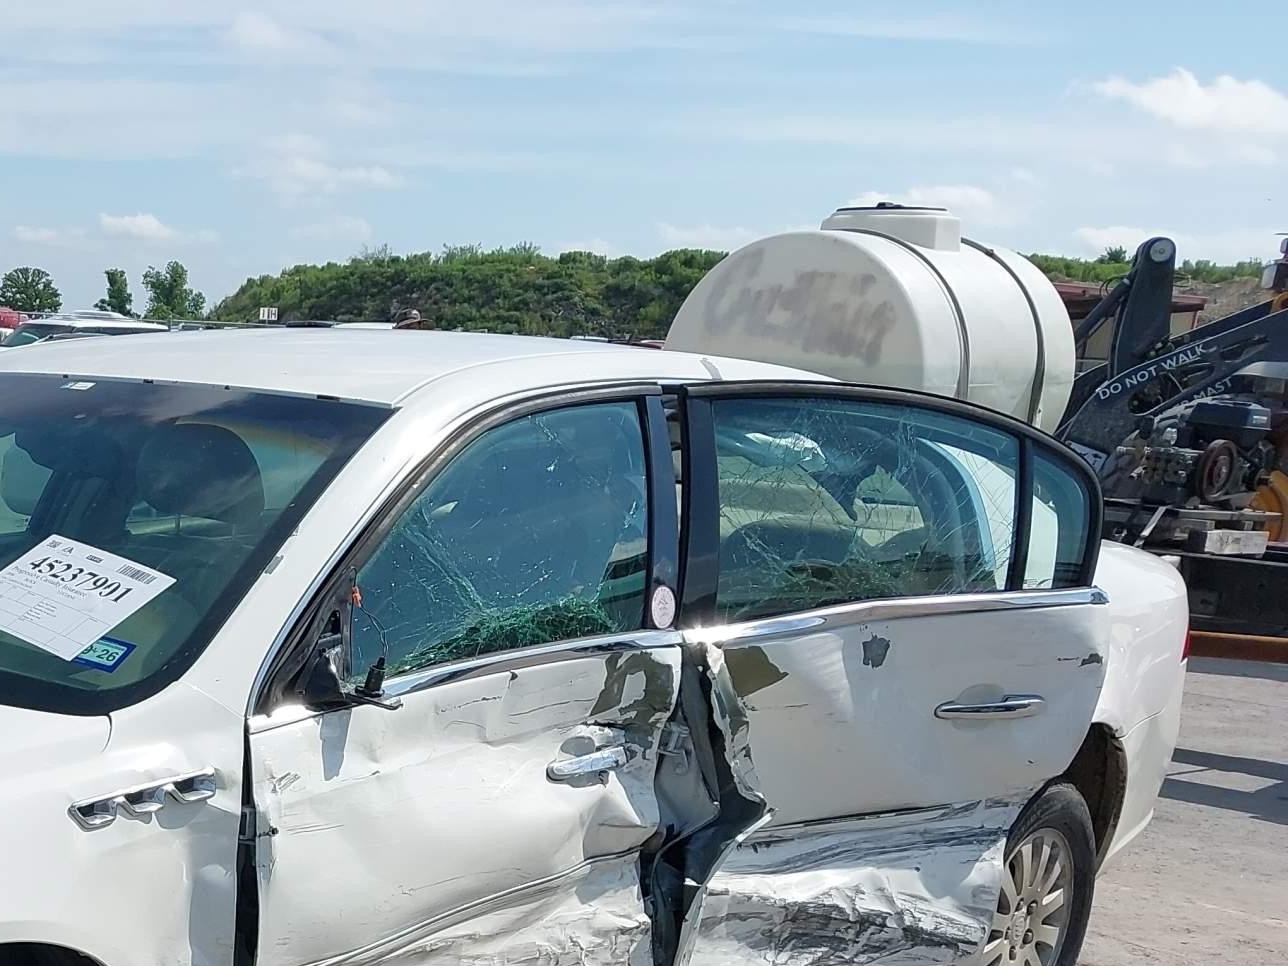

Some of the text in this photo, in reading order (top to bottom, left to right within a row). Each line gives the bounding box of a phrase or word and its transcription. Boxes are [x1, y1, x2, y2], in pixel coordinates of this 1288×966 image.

[1098, 343, 1207, 400] DO NOT WALK
[1193, 376, 1233, 400] MAST
[29, 556, 134, 603] 45237901
[96, 649, 119, 661] 26
